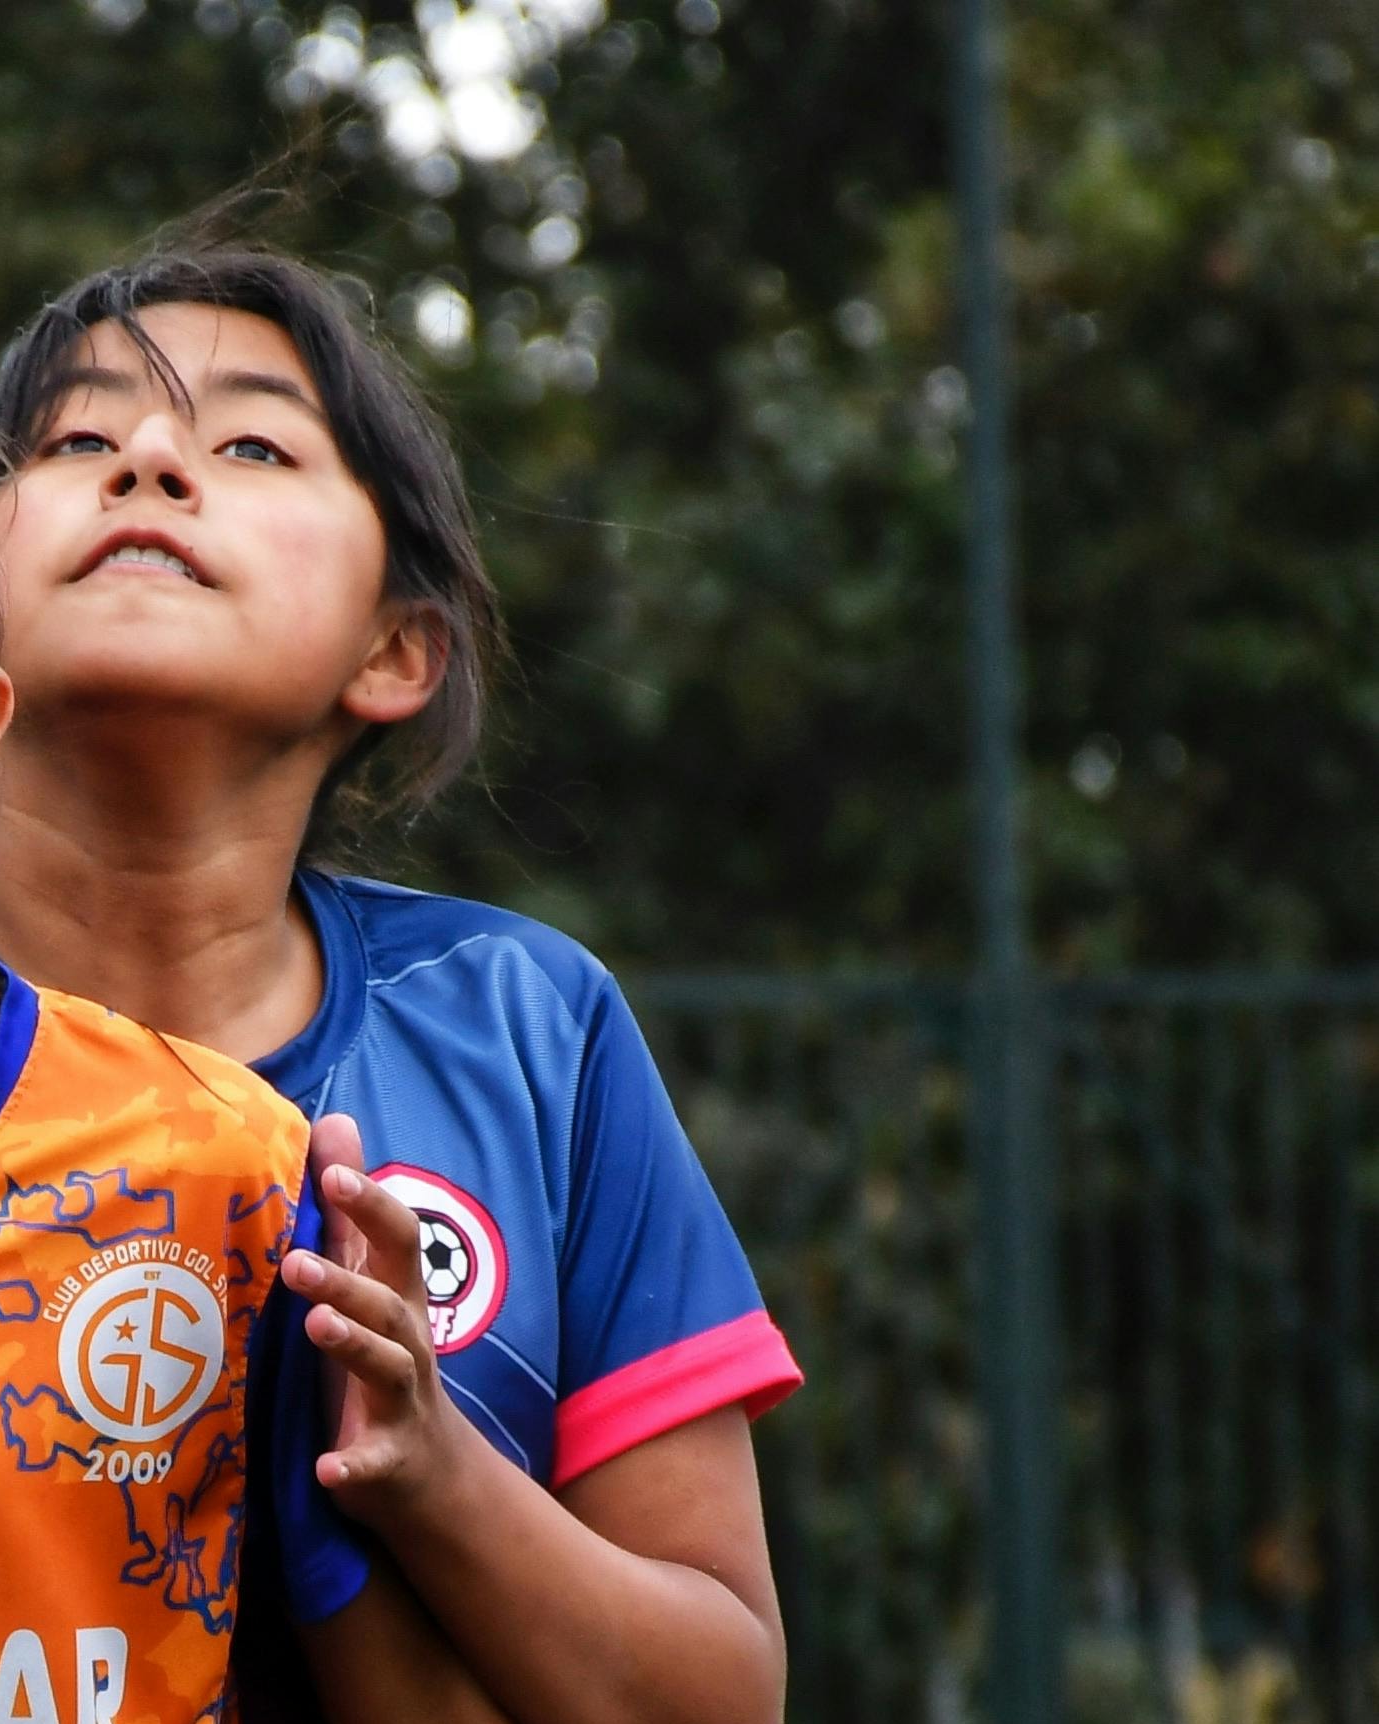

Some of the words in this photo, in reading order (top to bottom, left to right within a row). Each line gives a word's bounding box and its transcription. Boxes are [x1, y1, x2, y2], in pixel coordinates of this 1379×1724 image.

[42, 1275, 82, 1323] CLUB
[78, 1239, 182, 1281] DEPORTIVO
[184, 1248, 216, 1281] GOL
[82, 1449, 173, 1485] 2009
